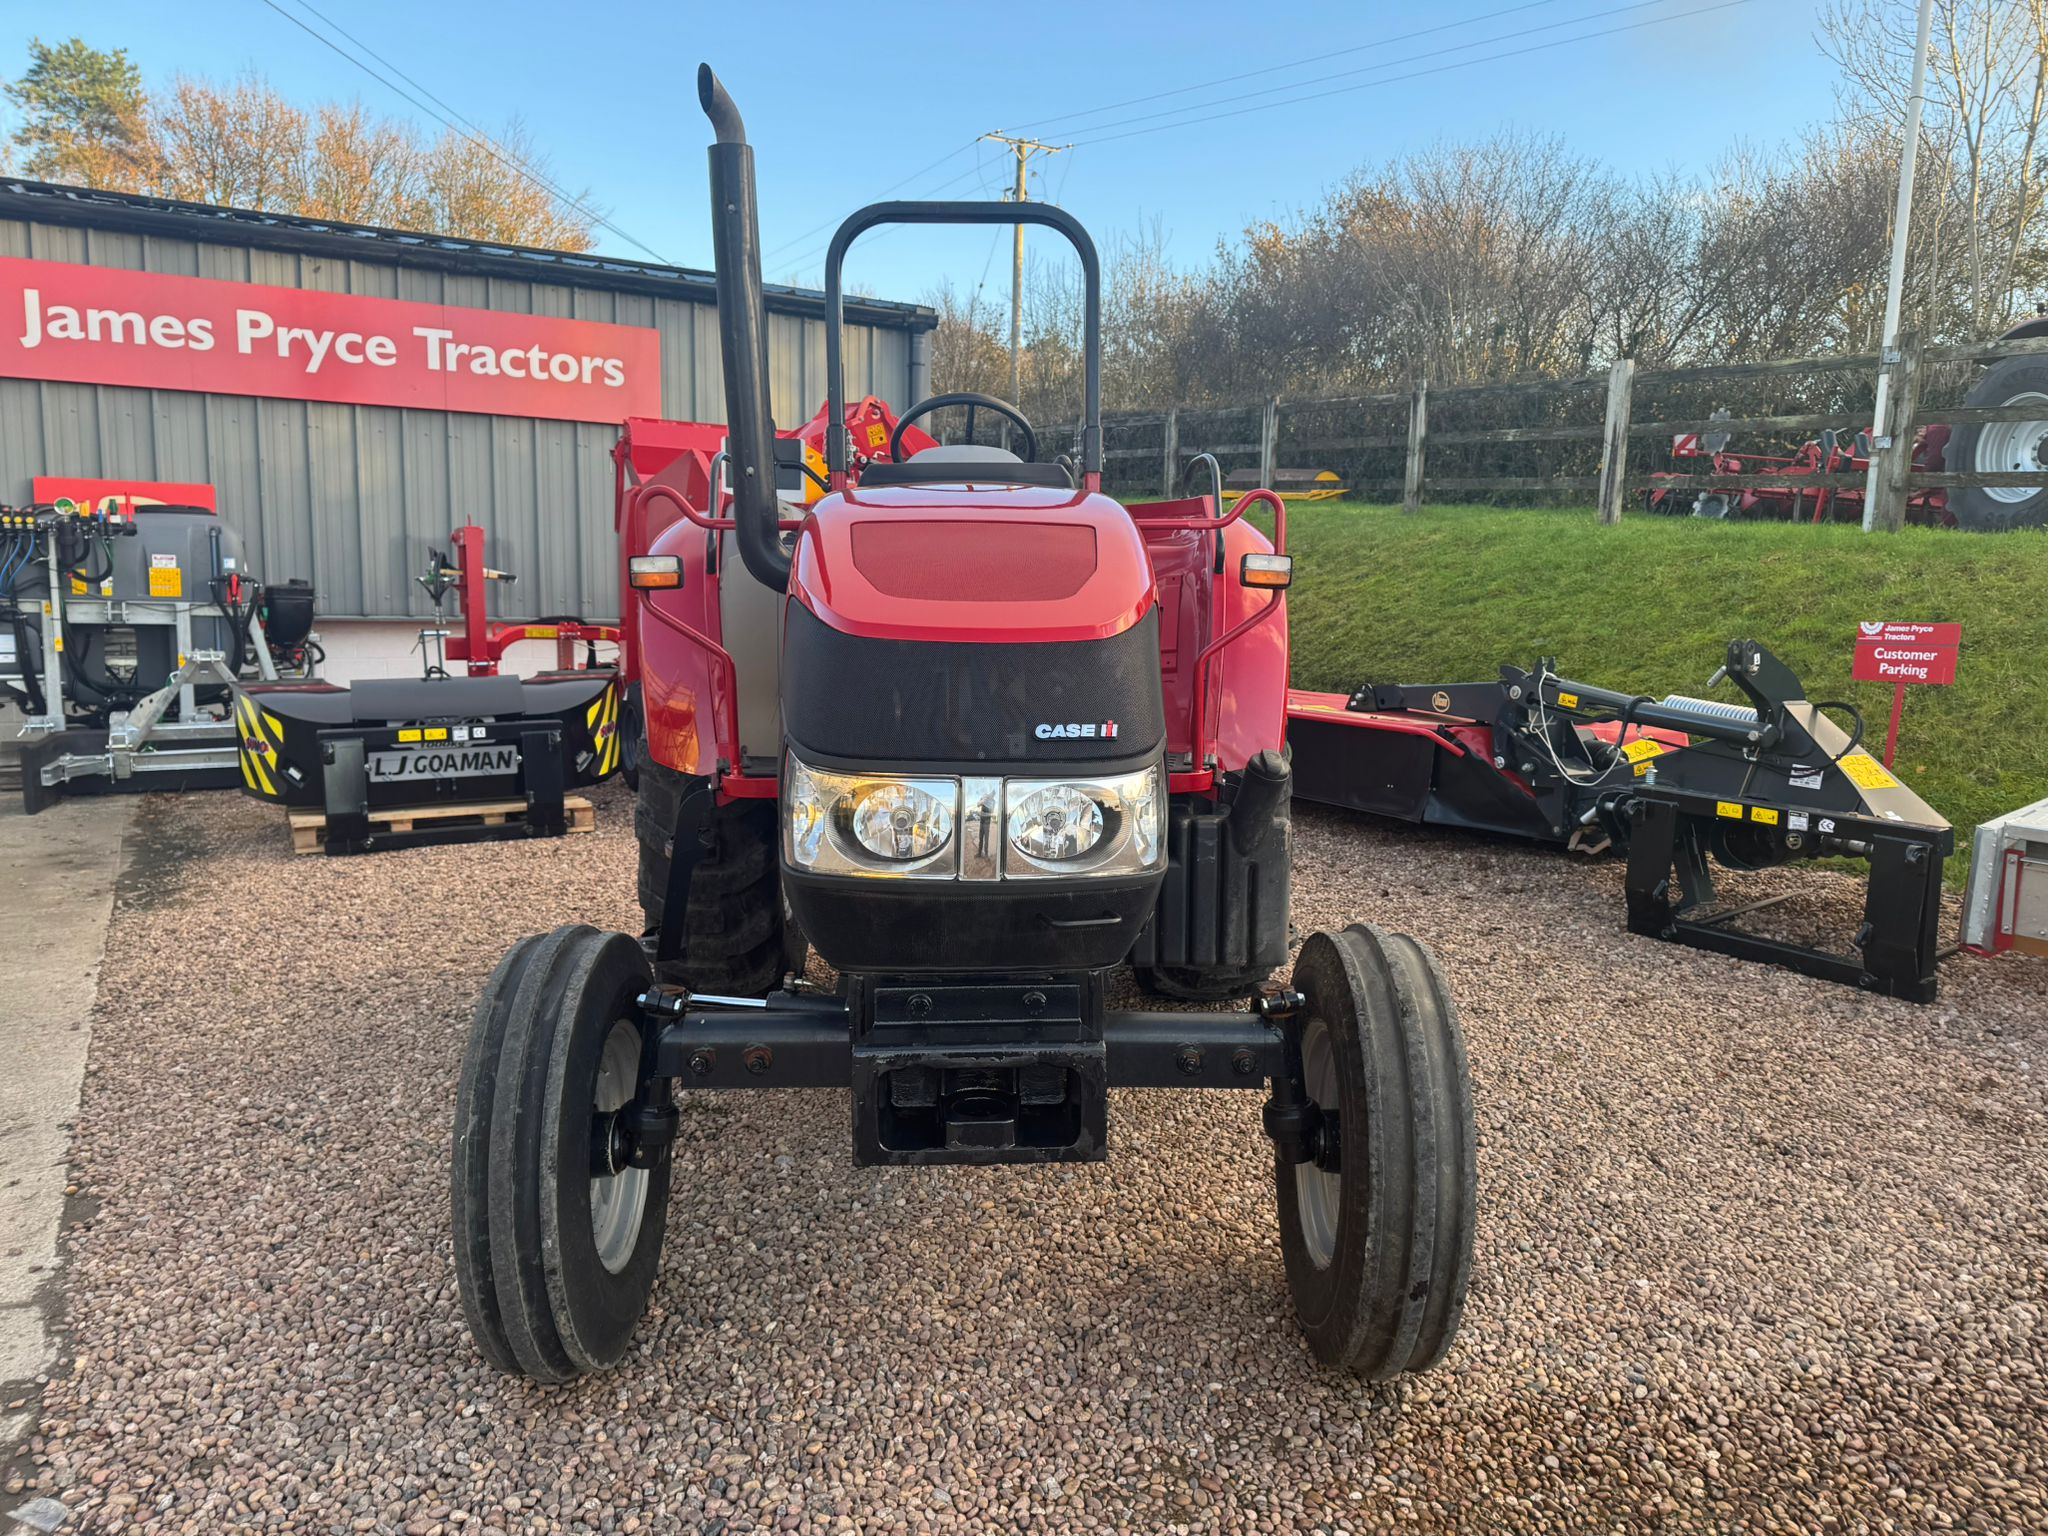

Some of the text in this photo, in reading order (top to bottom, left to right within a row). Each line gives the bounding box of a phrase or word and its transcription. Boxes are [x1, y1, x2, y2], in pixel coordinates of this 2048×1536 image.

[19, 287, 626, 388] James Pryce Tractors
[1884, 624, 1934, 634] James Pryce
[1884, 632, 1916, 641] Tractors
[1874, 647, 1938, 661] Customer
[1879, 662, 1928, 679] Parking
[1034, 723, 1096, 739] CASE
[373, 750, 513, 777] L.J.GOAMAN
